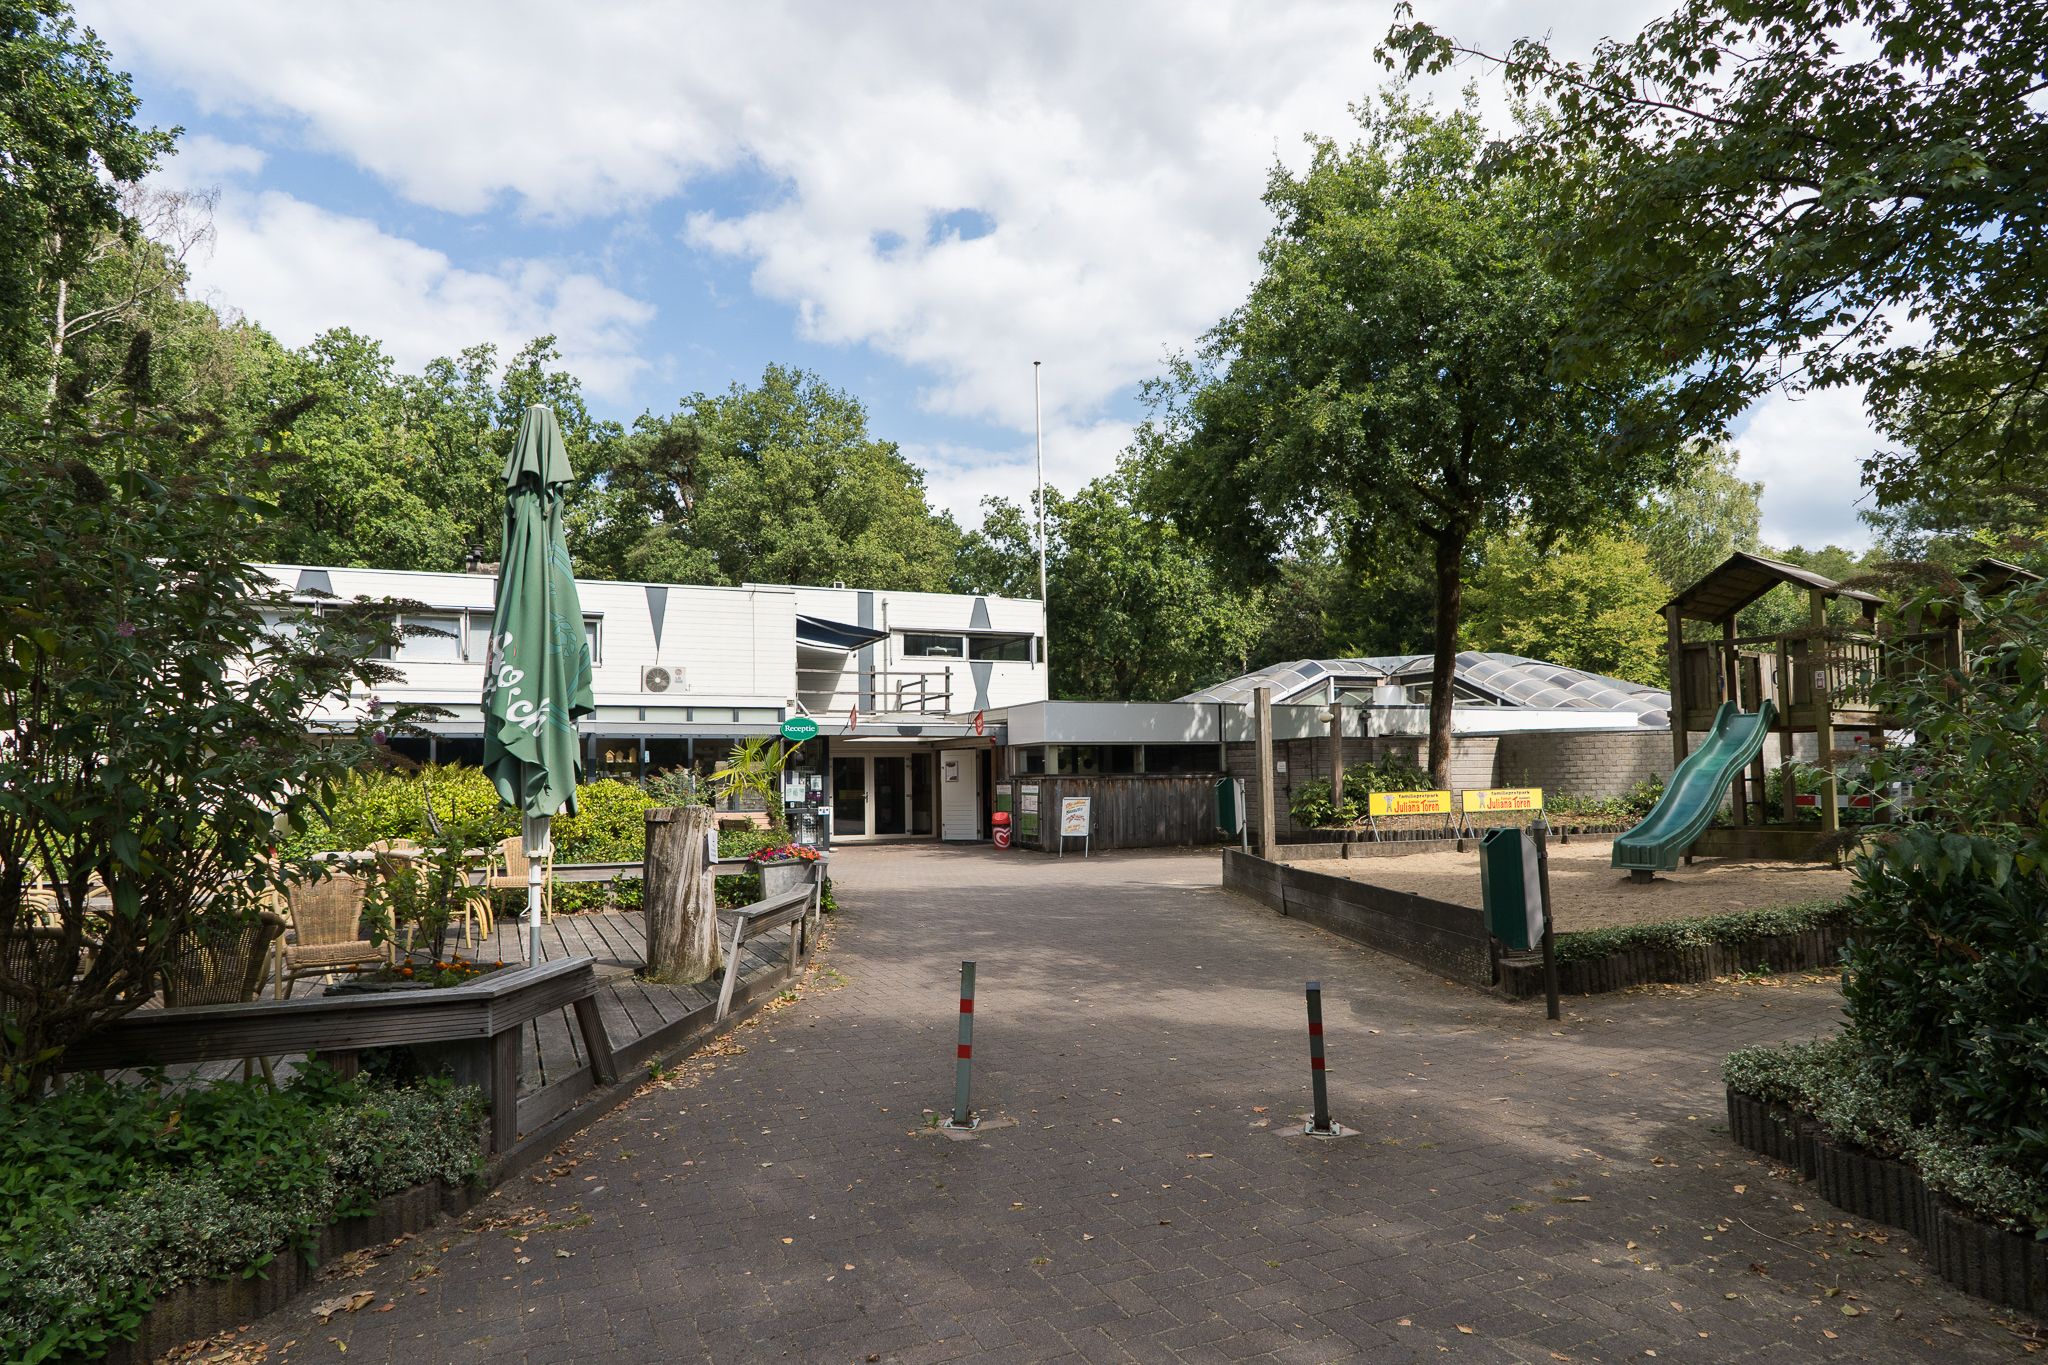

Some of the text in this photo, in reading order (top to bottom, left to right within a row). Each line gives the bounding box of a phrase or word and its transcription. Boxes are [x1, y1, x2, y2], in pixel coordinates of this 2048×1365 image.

[785, 724, 816, 734] Receptie
[1394, 799, 1440, 813] Juliana Toren
[1487, 796, 1531, 809] Juliana Toren
